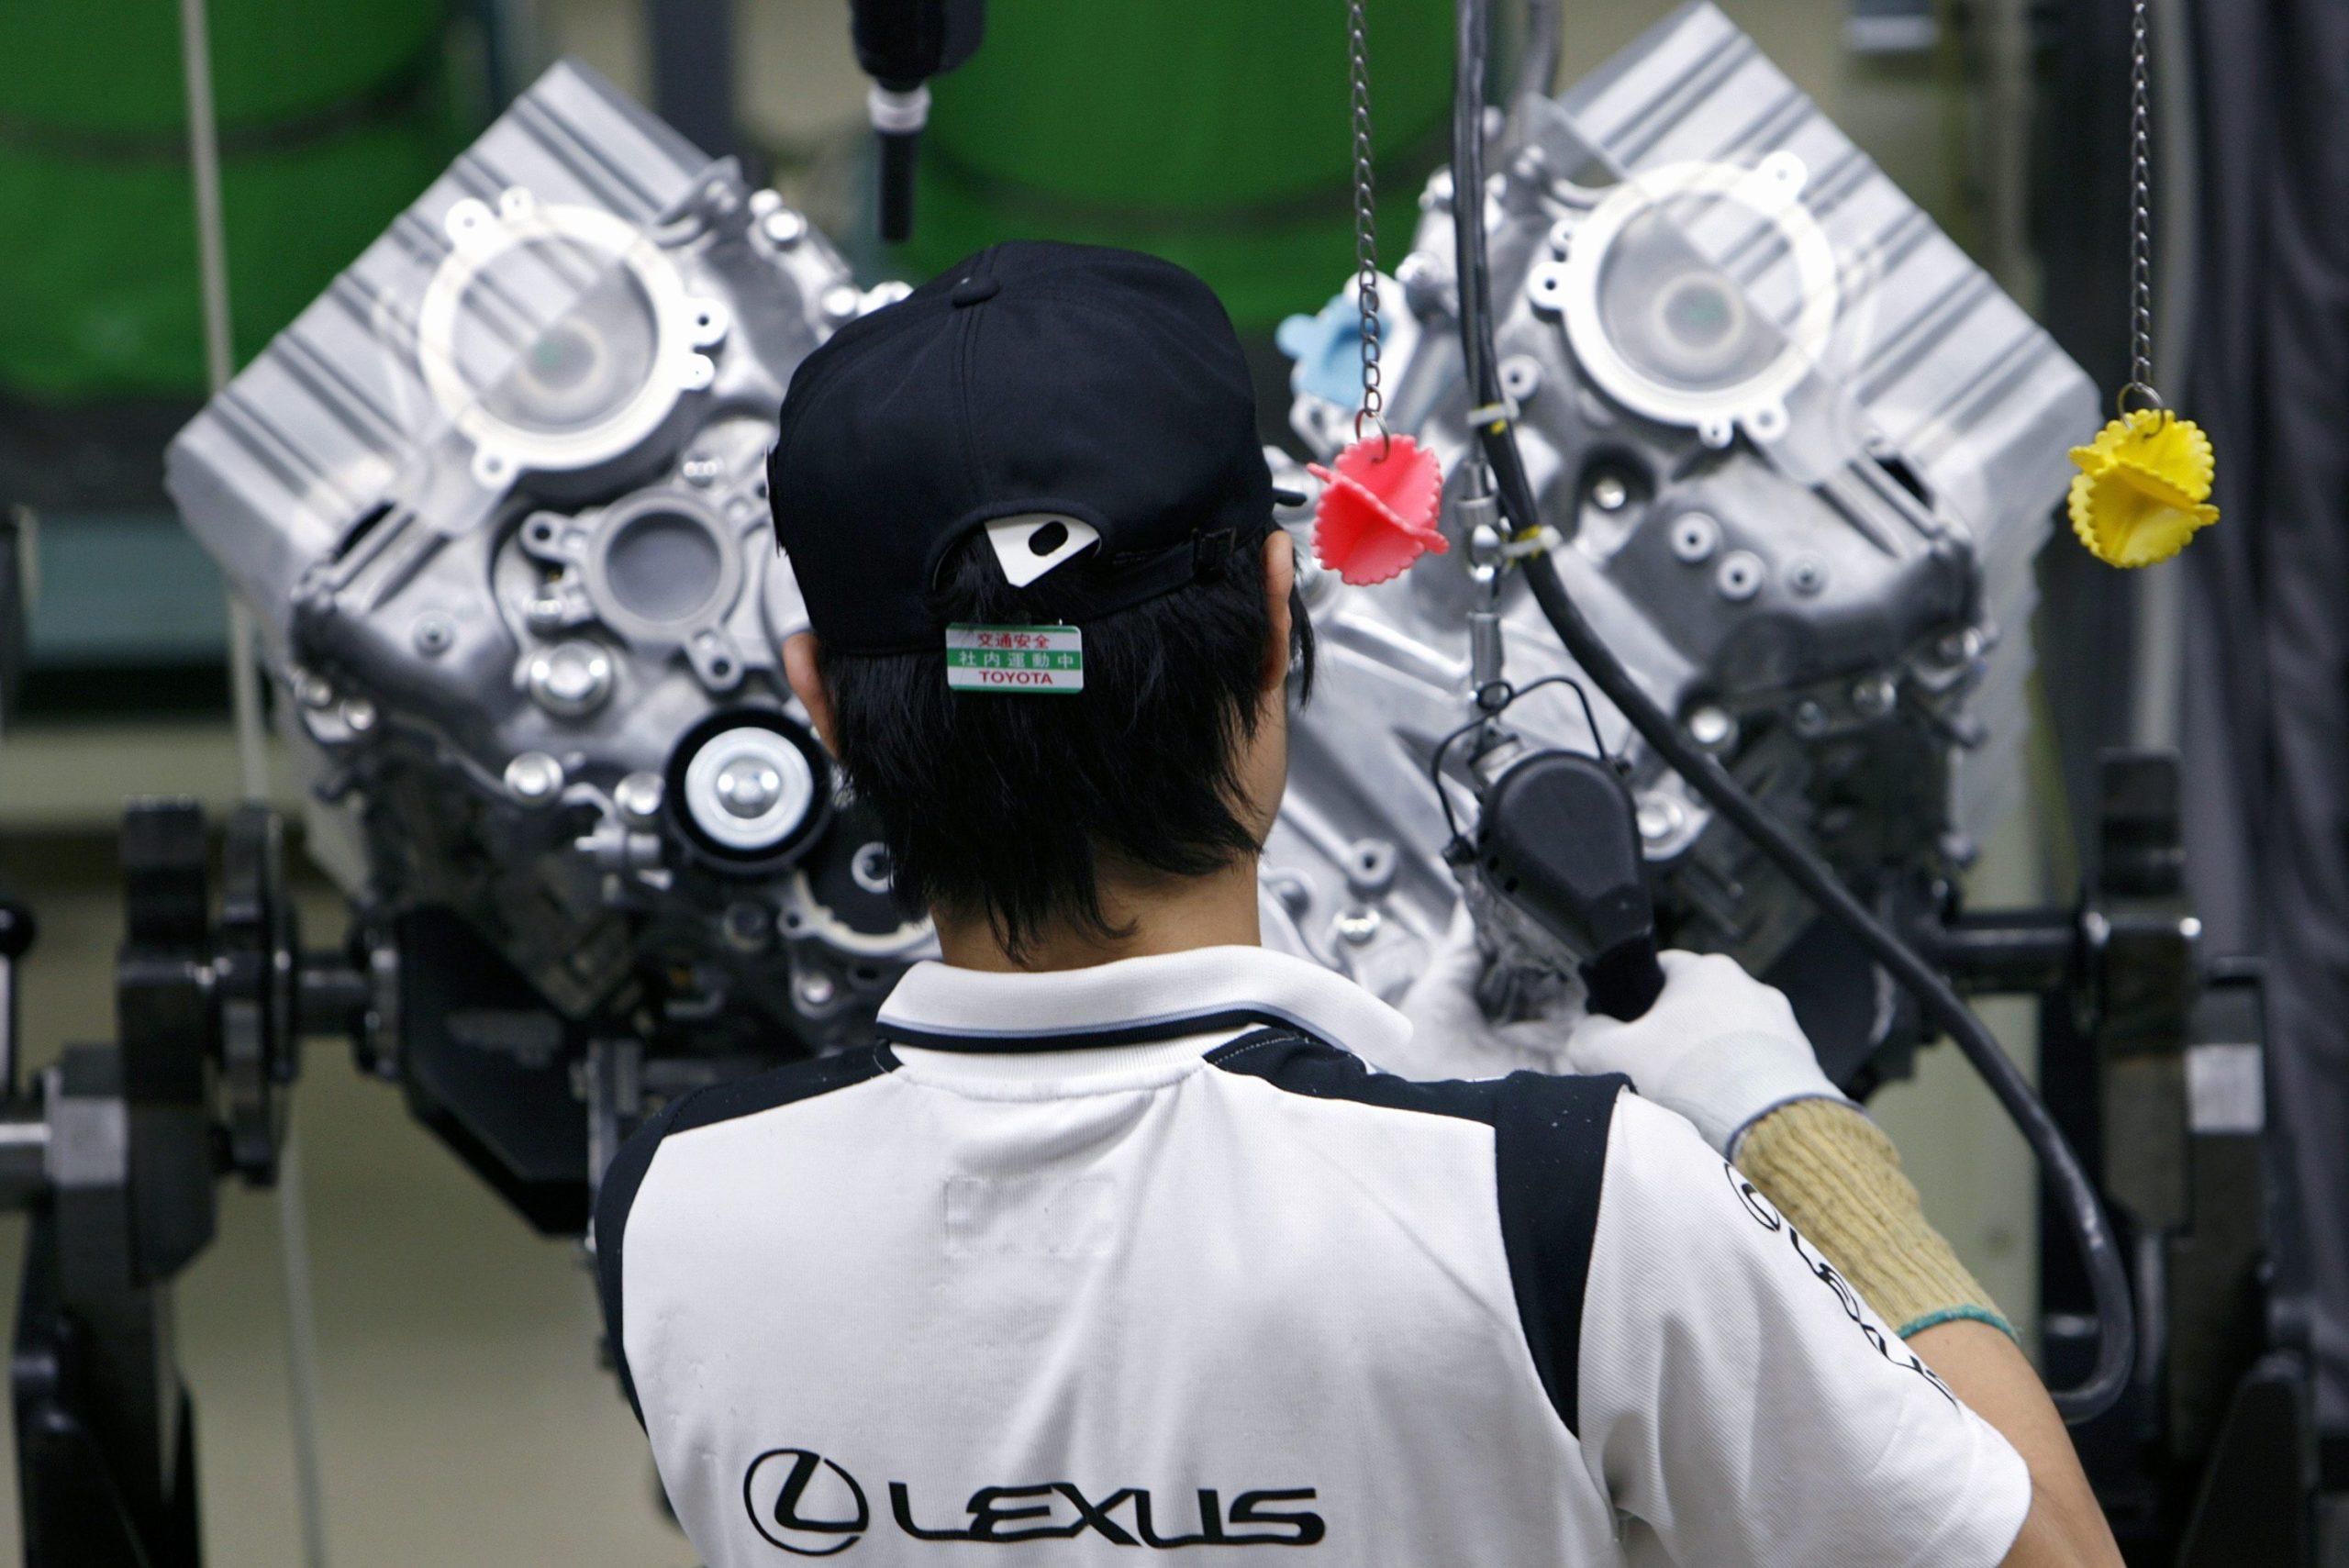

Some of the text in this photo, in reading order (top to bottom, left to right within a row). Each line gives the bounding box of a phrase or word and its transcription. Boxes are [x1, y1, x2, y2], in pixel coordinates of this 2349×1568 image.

[978, 633, 1050, 648] 交通安全
[959, 651, 1074, 669] 社内運動中
[979, 671, 1052, 684] TOYOTA
[888, 1482, 1326, 1549] LEXUS
